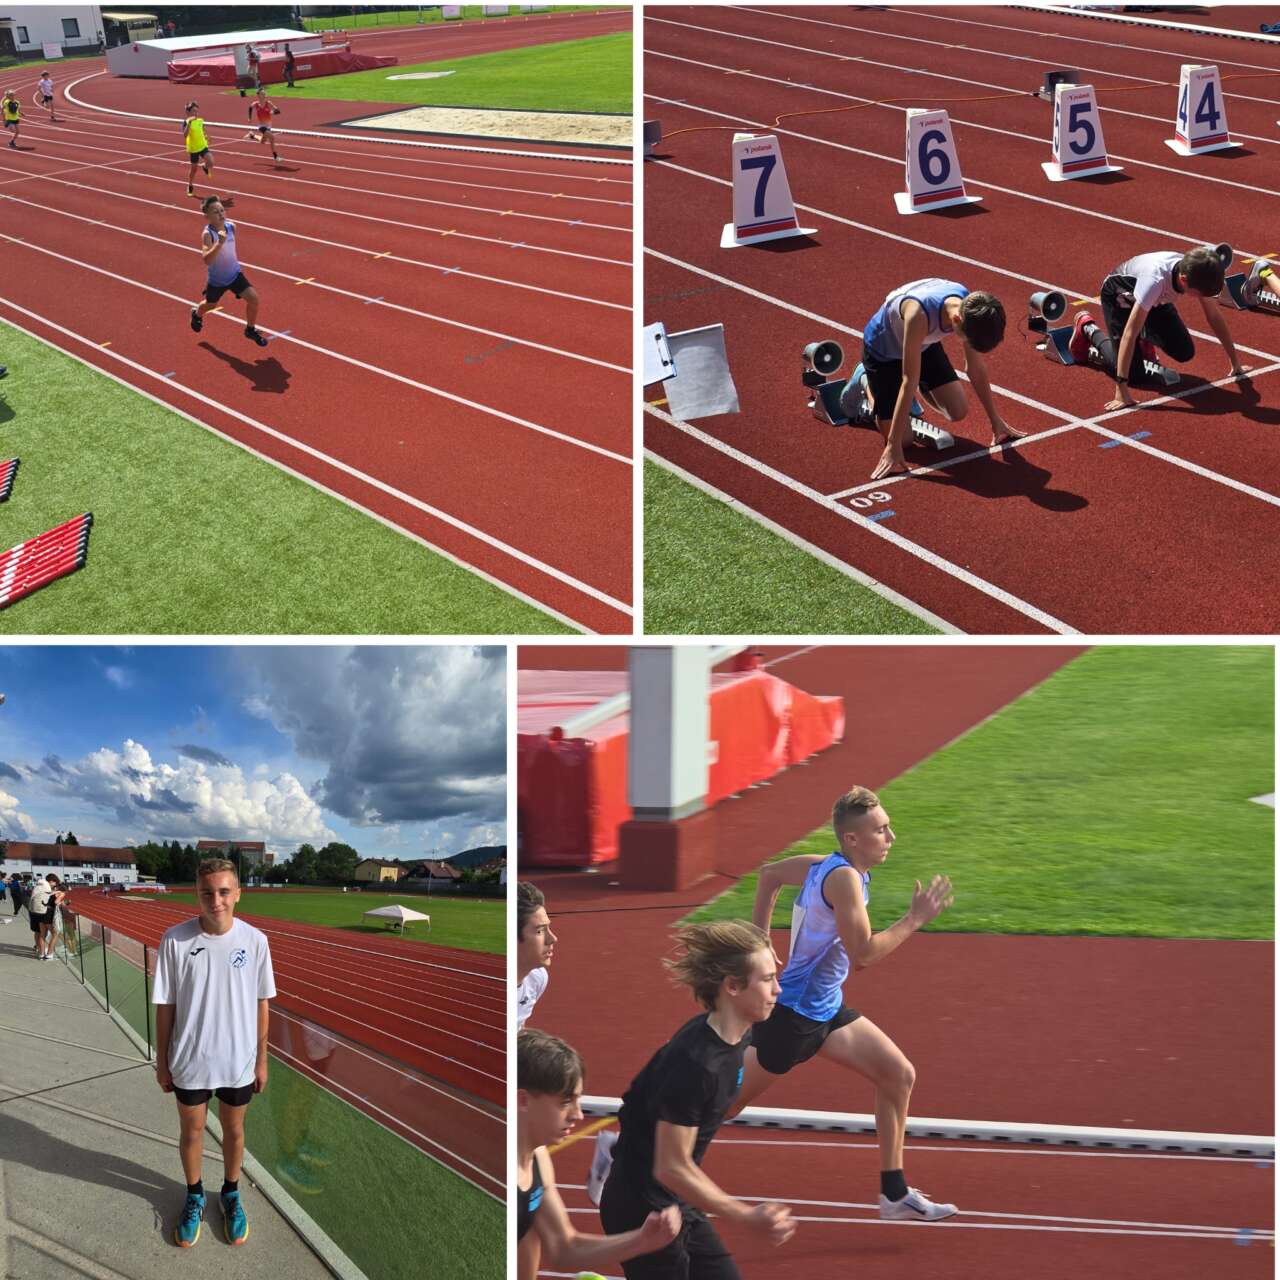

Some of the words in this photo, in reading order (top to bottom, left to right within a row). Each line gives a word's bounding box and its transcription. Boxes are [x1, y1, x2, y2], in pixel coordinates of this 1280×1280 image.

[1069, 102, 1096, 155] 5
[1179, 84, 1188, 132] 4
[1195, 82, 1221, 131] 4
[918, 129, 951, 186] 6
[740, 154, 777, 218] 7
